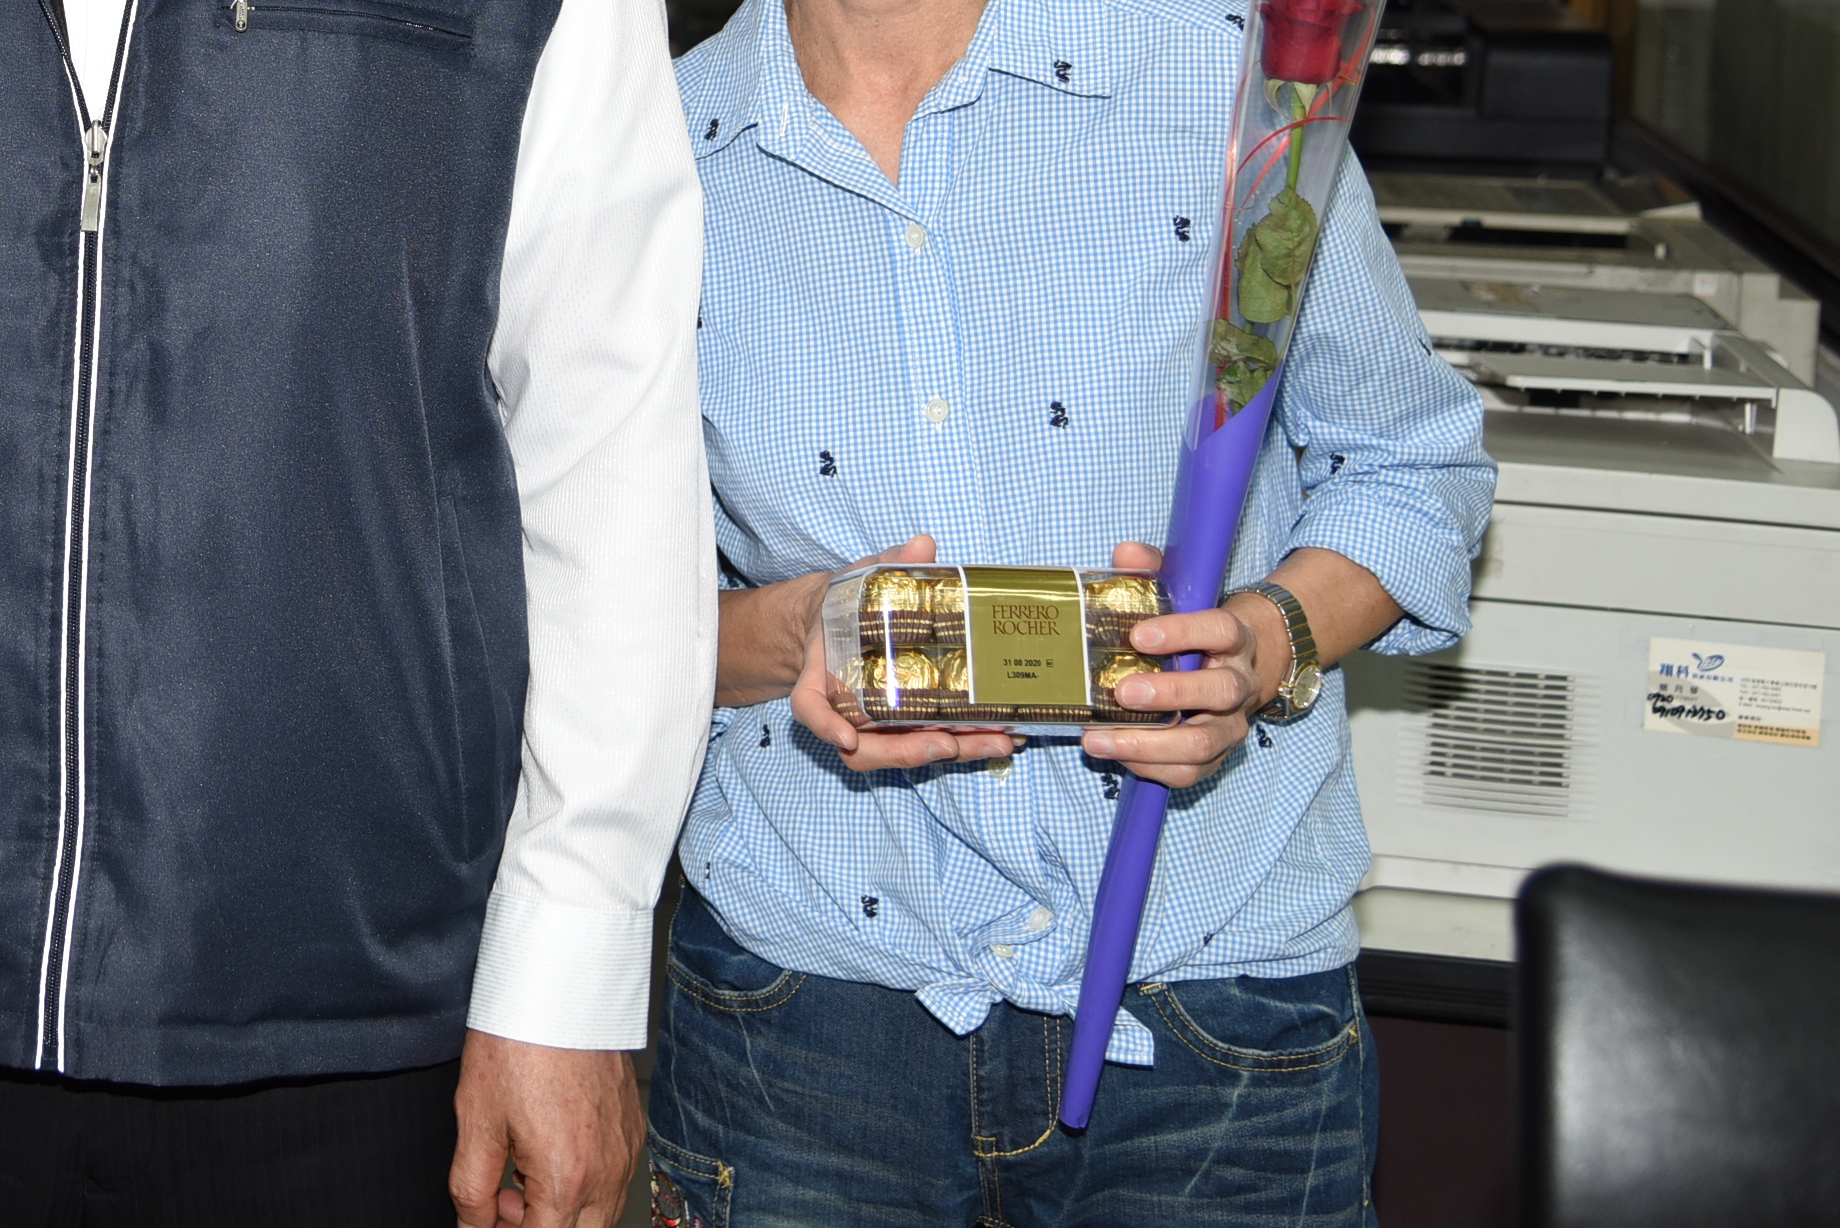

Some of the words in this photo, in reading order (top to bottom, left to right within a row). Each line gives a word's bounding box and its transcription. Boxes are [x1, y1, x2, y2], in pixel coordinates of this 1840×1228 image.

[992, 604, 1059, 621] FERRERO
[992, 620, 1060, 636] ROCHER
[1003, 658, 1012, 666] 31
[1024, 658, 1042, 667] 2020
